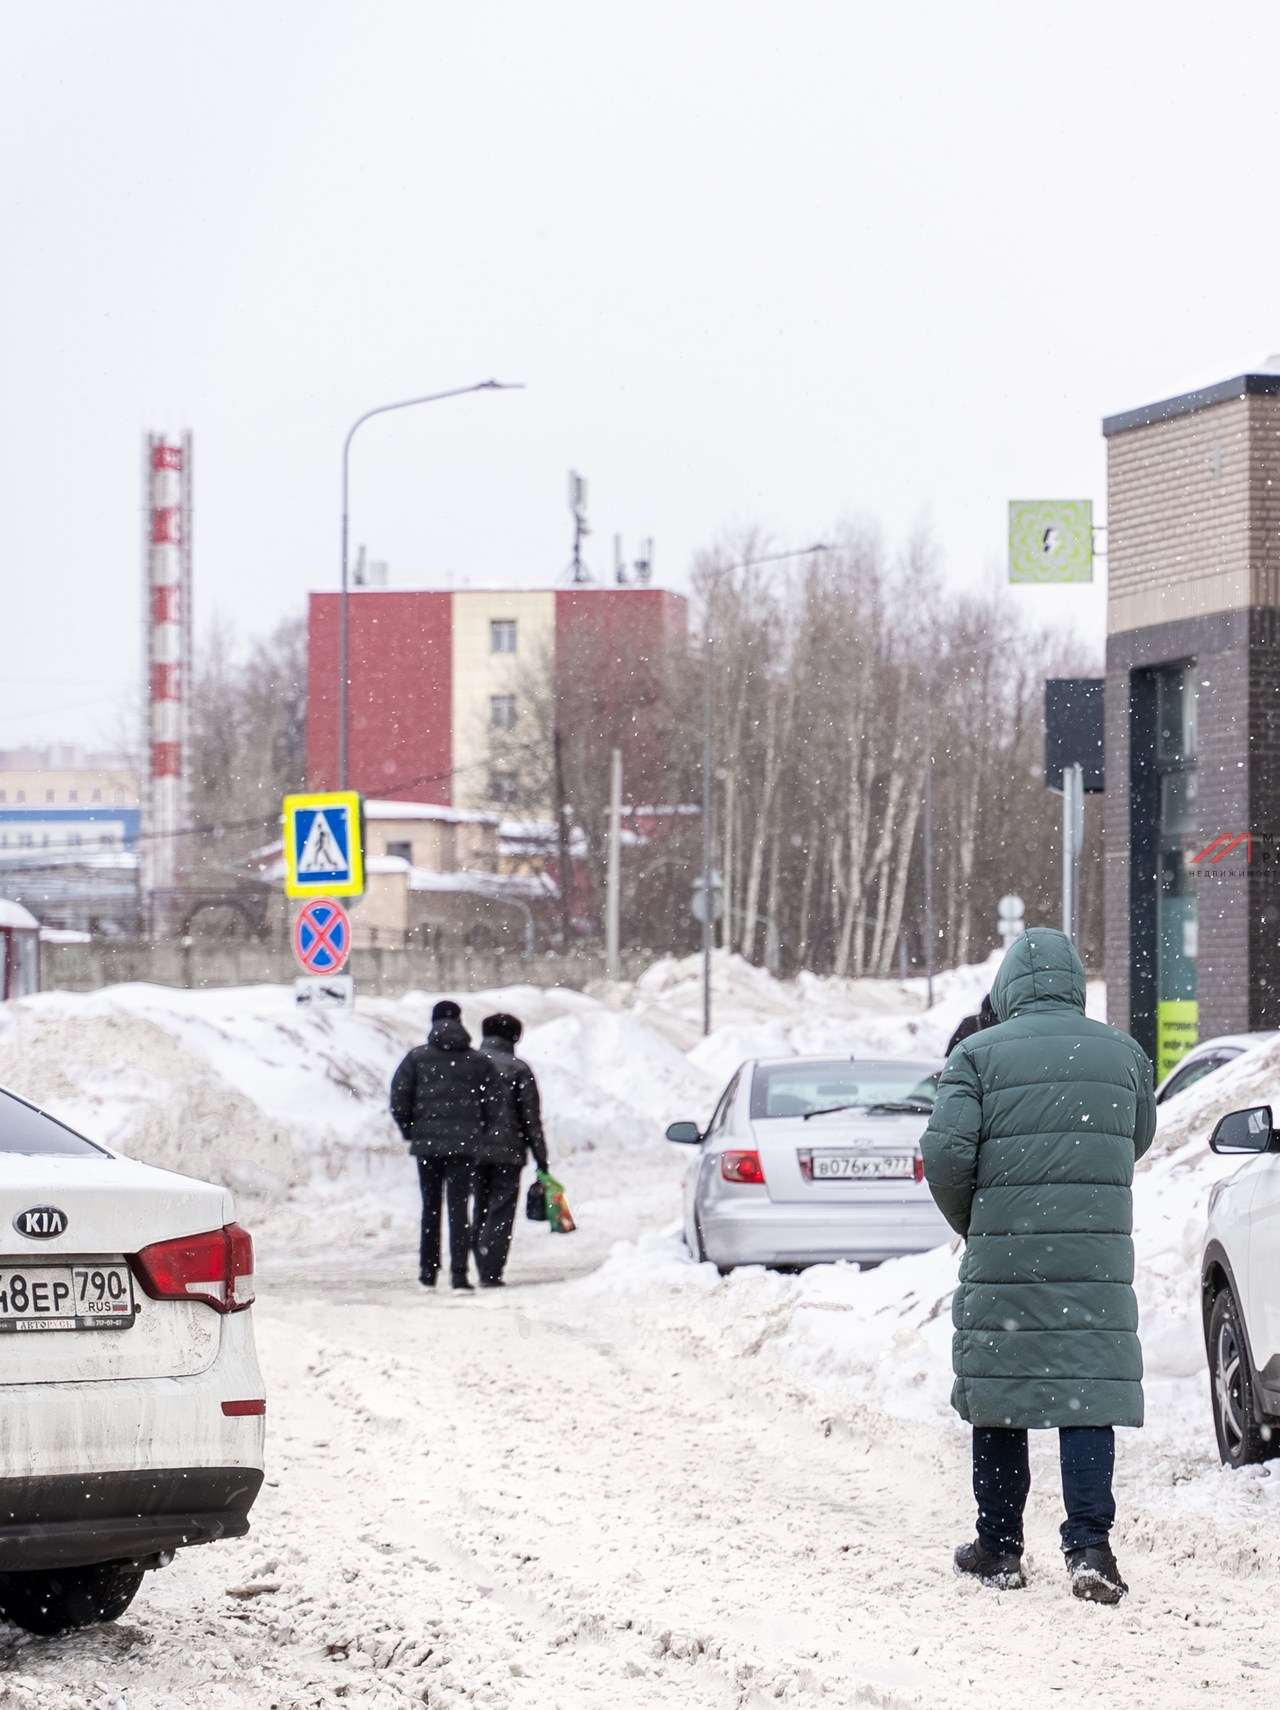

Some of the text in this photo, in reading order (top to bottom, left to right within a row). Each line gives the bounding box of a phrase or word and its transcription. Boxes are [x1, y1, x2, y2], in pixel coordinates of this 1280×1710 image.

[25, 1213, 62, 1233] KIA
[75, 1270, 122, 1301] 790
[88, 1301, 111, 1312] RUS
